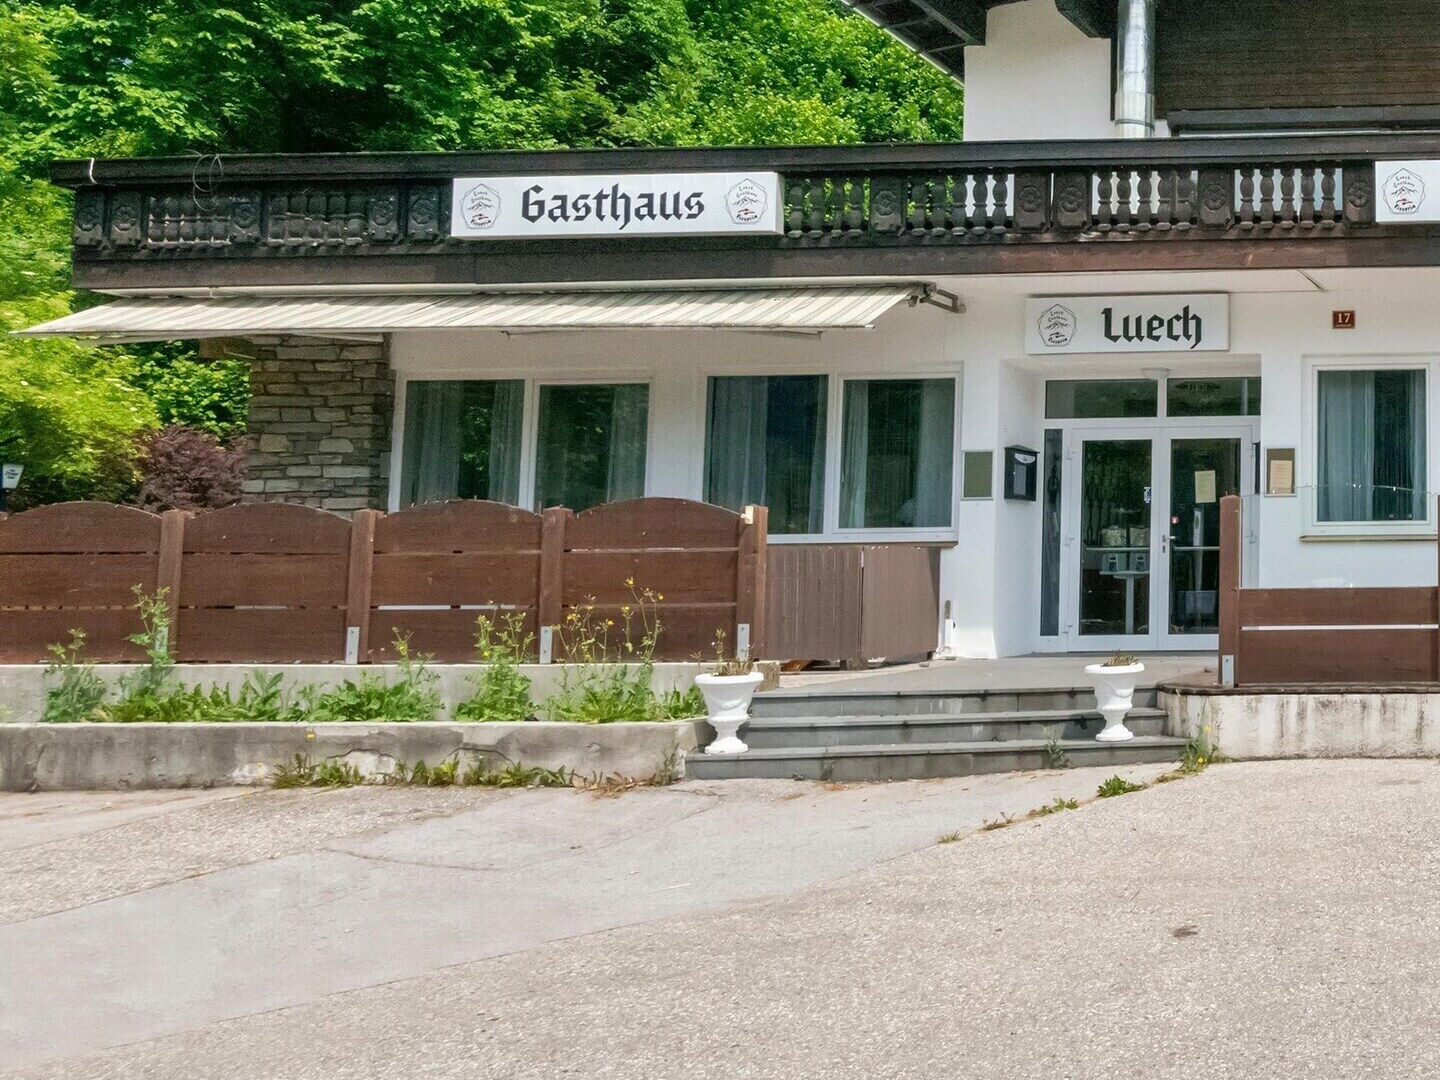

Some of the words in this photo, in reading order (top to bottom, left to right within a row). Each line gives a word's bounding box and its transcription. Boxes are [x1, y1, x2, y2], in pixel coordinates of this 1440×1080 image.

[521, 183, 705, 230] Gasthaus
[1101, 304, 1202, 349] Luech
[1337, 312, 1351, 324] 17
